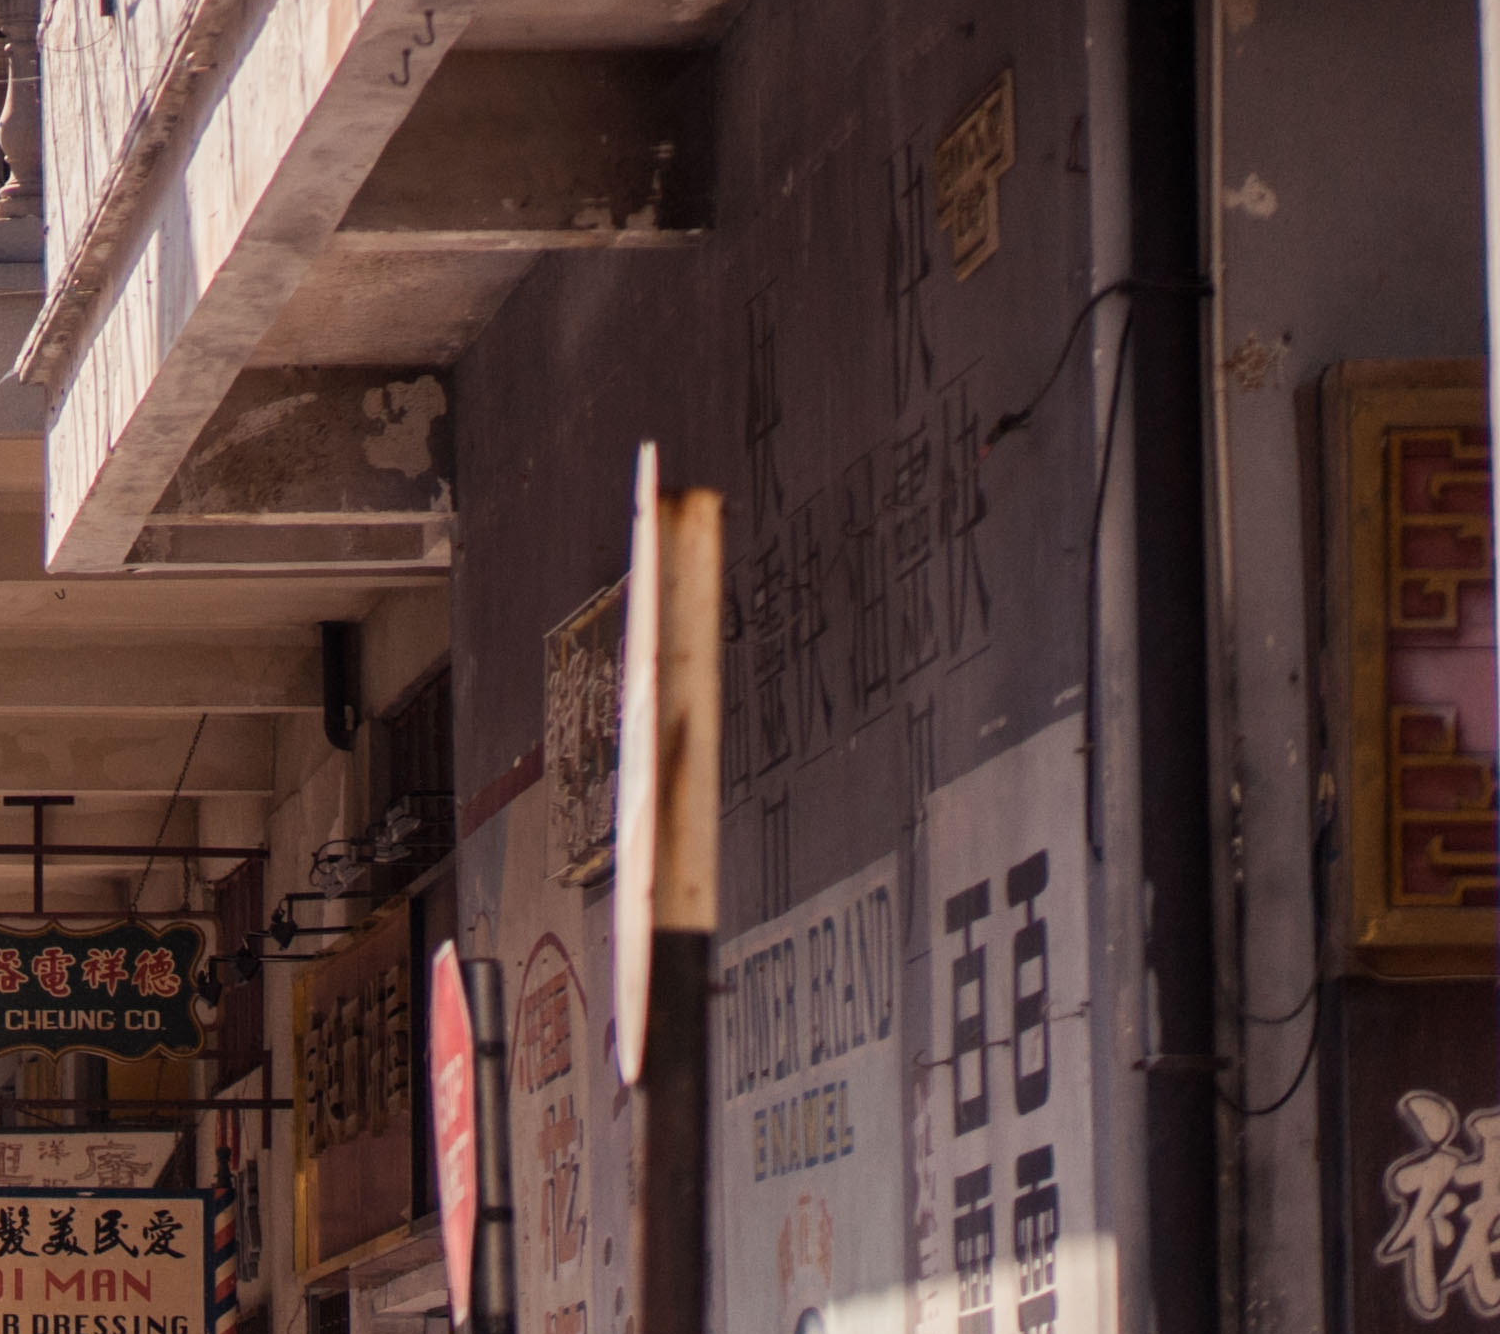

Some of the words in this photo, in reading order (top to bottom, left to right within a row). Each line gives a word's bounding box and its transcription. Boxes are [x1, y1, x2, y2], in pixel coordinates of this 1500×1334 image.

[4, 1009, 118, 1033] CHEUNG
[123, 1009, 168, 1033] CO.
[44, 1266, 153, 1303] MAN
